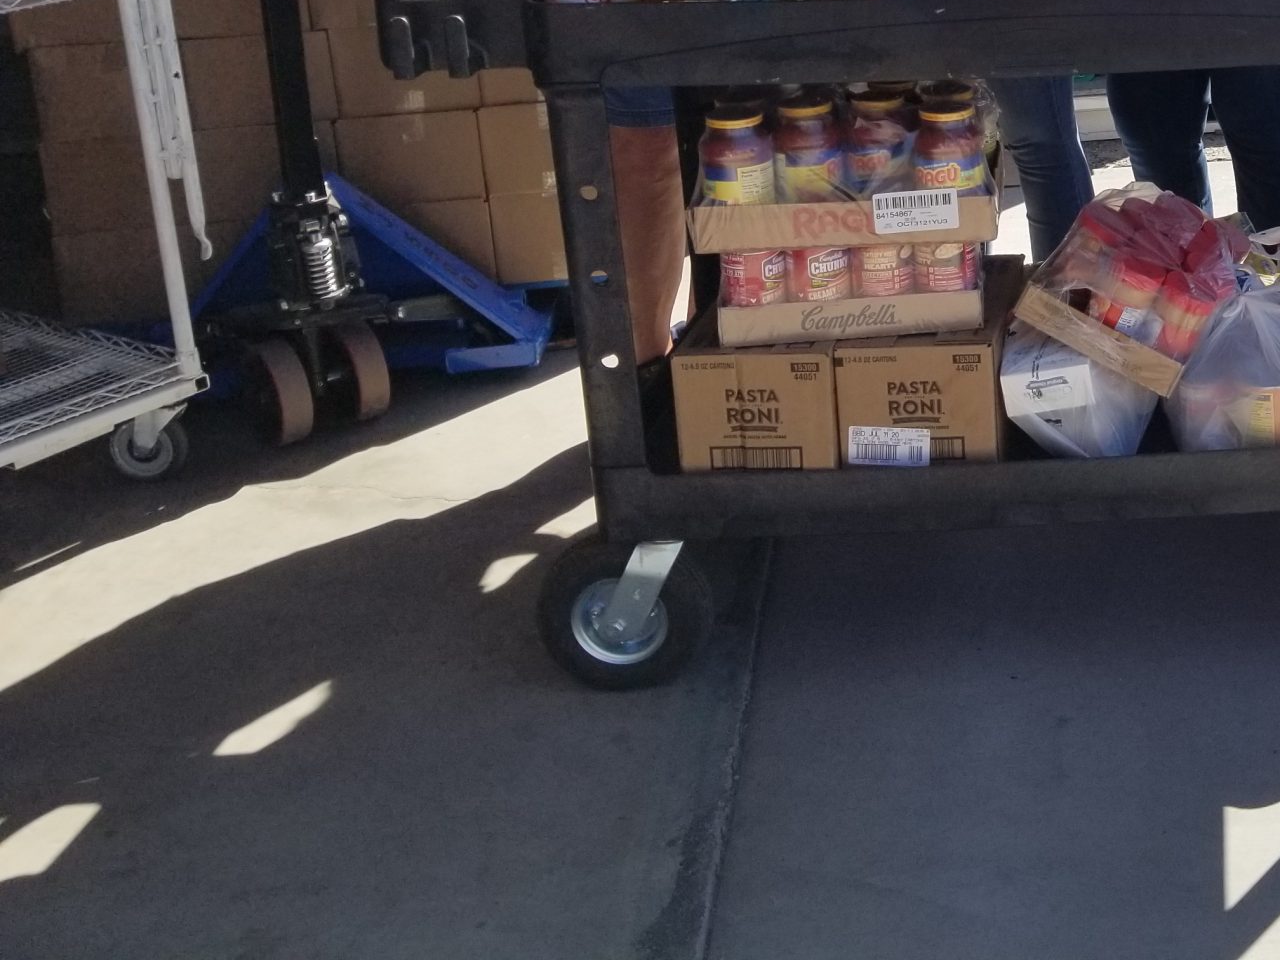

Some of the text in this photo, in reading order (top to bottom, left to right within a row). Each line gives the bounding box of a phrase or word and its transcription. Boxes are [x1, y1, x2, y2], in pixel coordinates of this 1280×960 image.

[810, 255, 848, 275] CHUNKY
[801, 303, 898, 334] Campbell's
[956, 364, 978, 372] 44051
[793, 372, 817, 381] 44051
[887, 380, 942, 395] PASTA
[725, 389, 779, 403] PASTA
[888, 398, 942, 416] RONI
[726, 407, 780, 425] RONI
